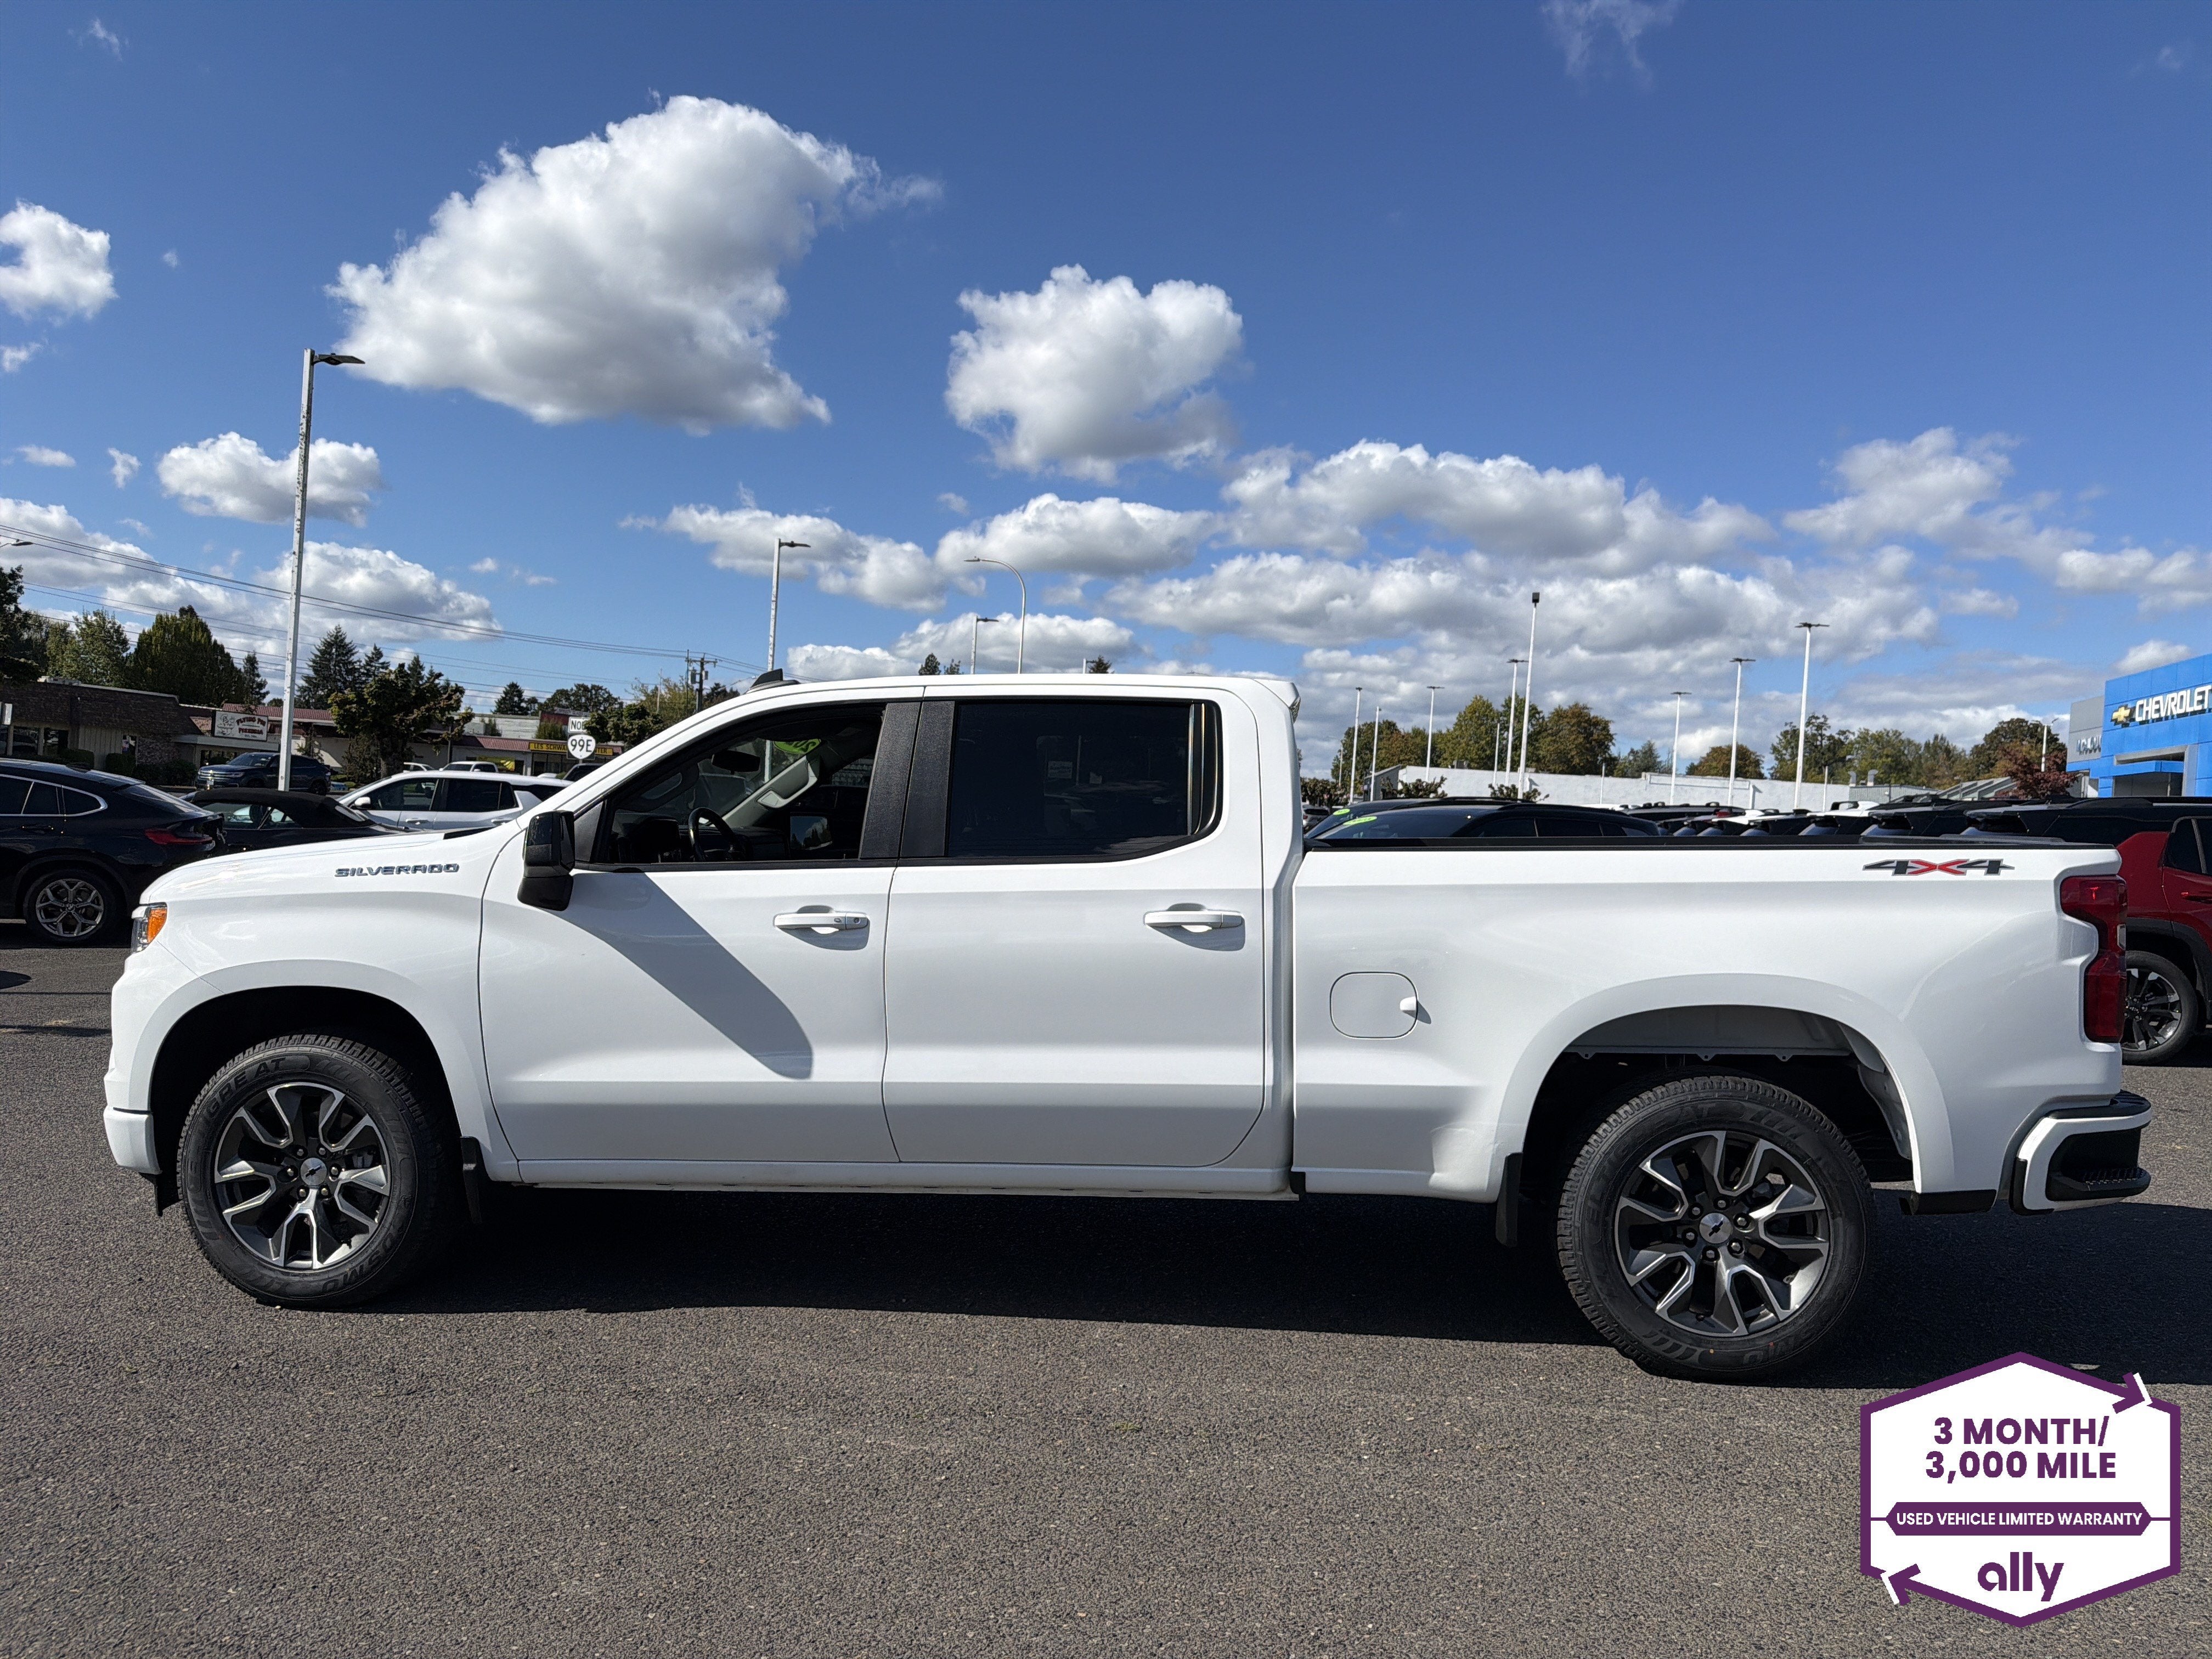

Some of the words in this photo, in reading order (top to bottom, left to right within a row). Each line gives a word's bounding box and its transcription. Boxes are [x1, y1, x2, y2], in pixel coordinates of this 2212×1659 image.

[2135, 685, 2212, 722] CHEVROLET
[571, 739, 592, 752] 99E
[335, 863, 460, 877] SILVERADO
[1862, 858, 2016, 877] 4X4
